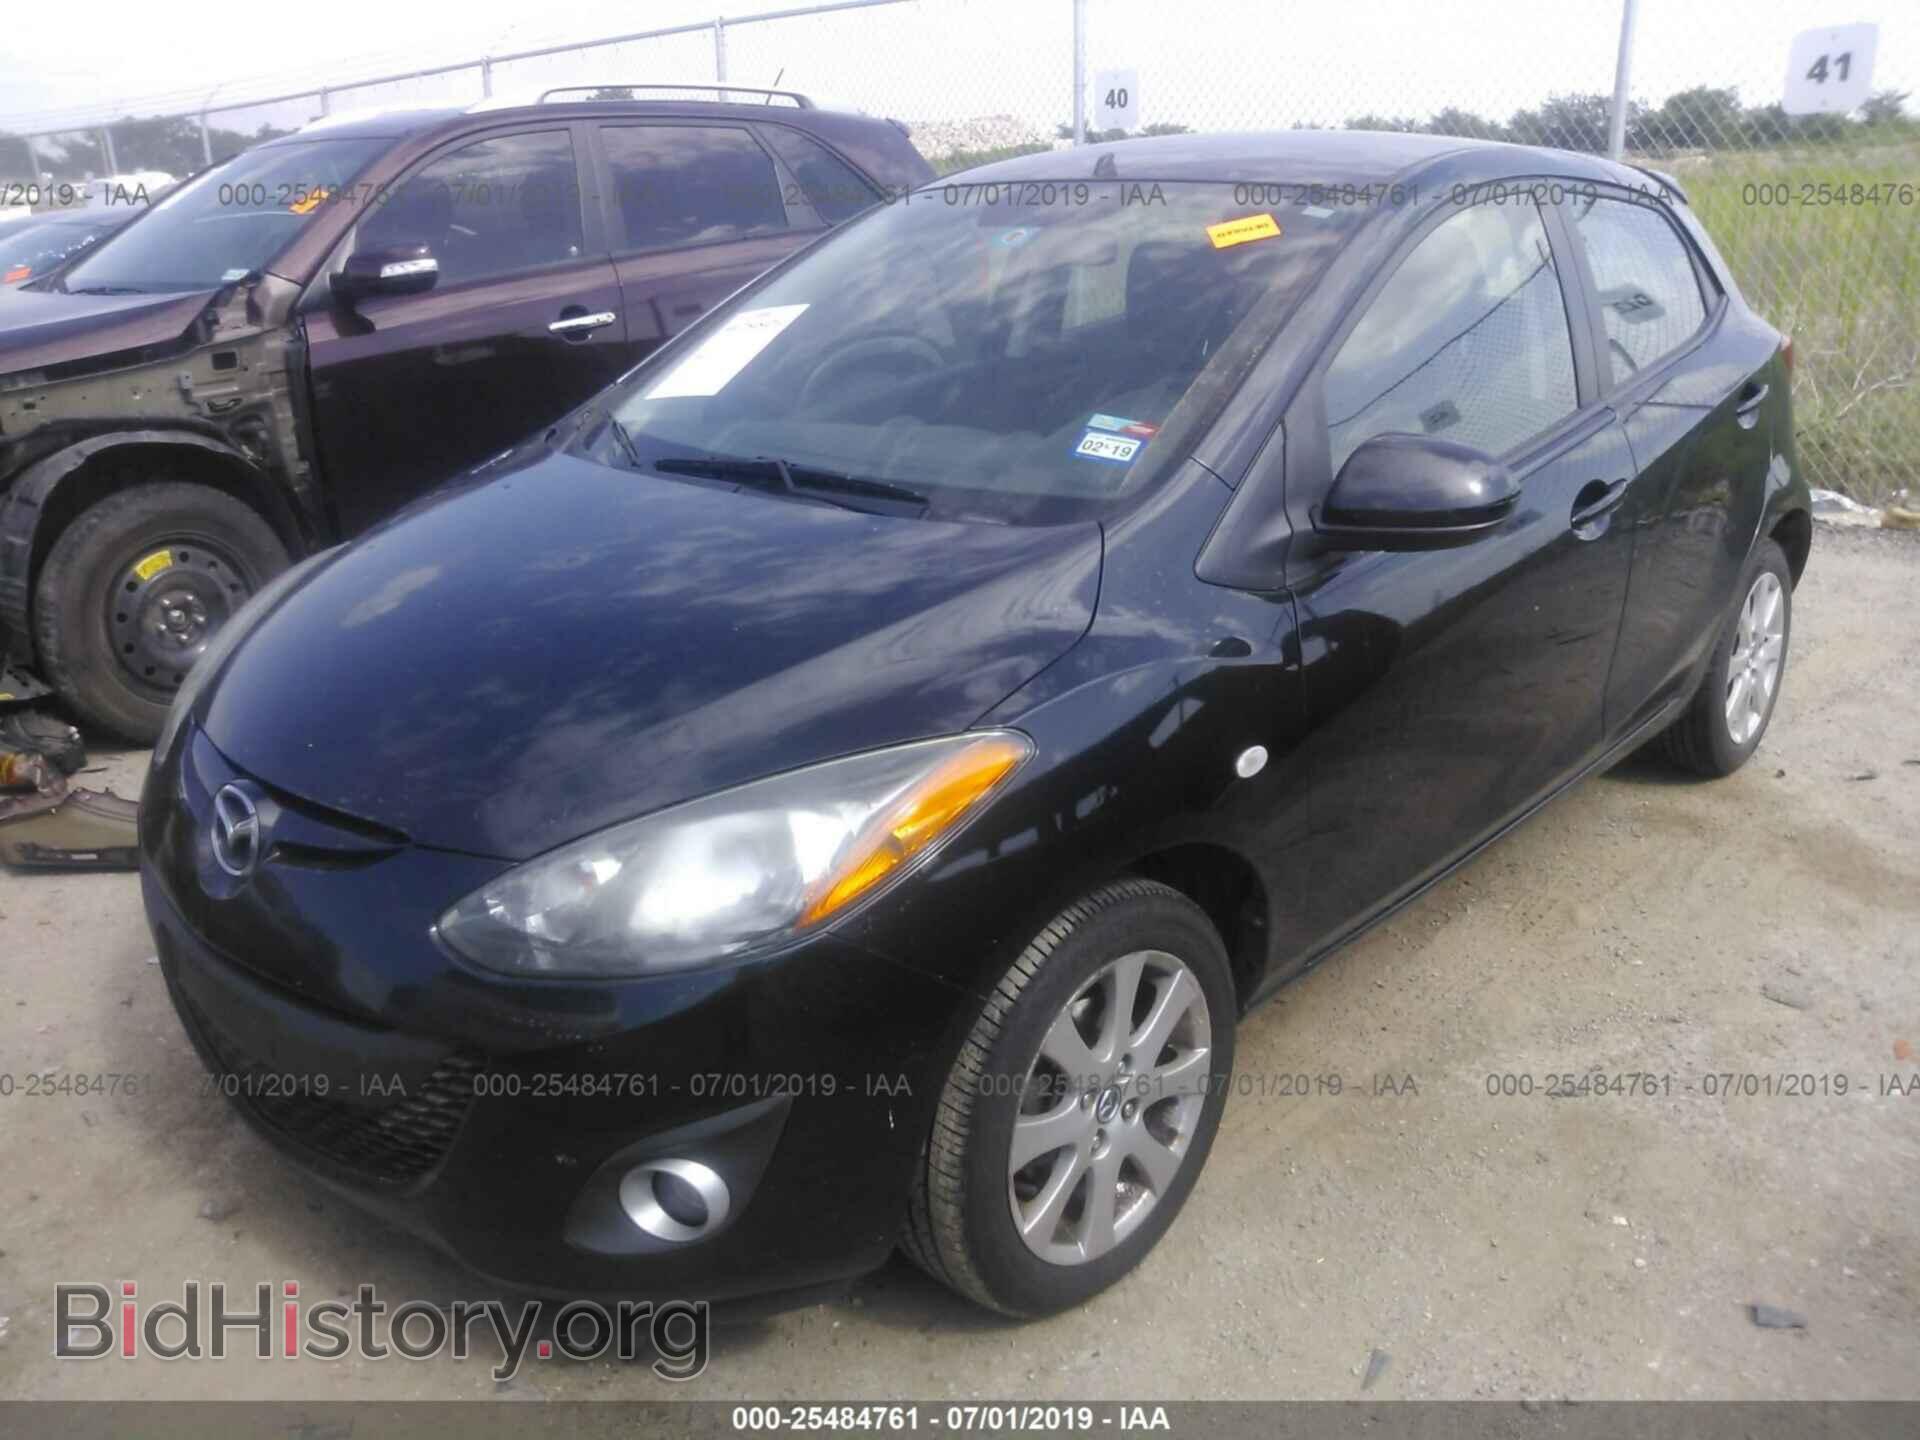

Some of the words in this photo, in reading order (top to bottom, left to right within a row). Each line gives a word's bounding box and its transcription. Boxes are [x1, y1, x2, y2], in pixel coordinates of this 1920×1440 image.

[1806, 51, 1852, 83] 41
[1105, 88, 1128, 109] 40
[1082, 440, 1104, 453] 02
[1112, 446, 1132, 458] 19
